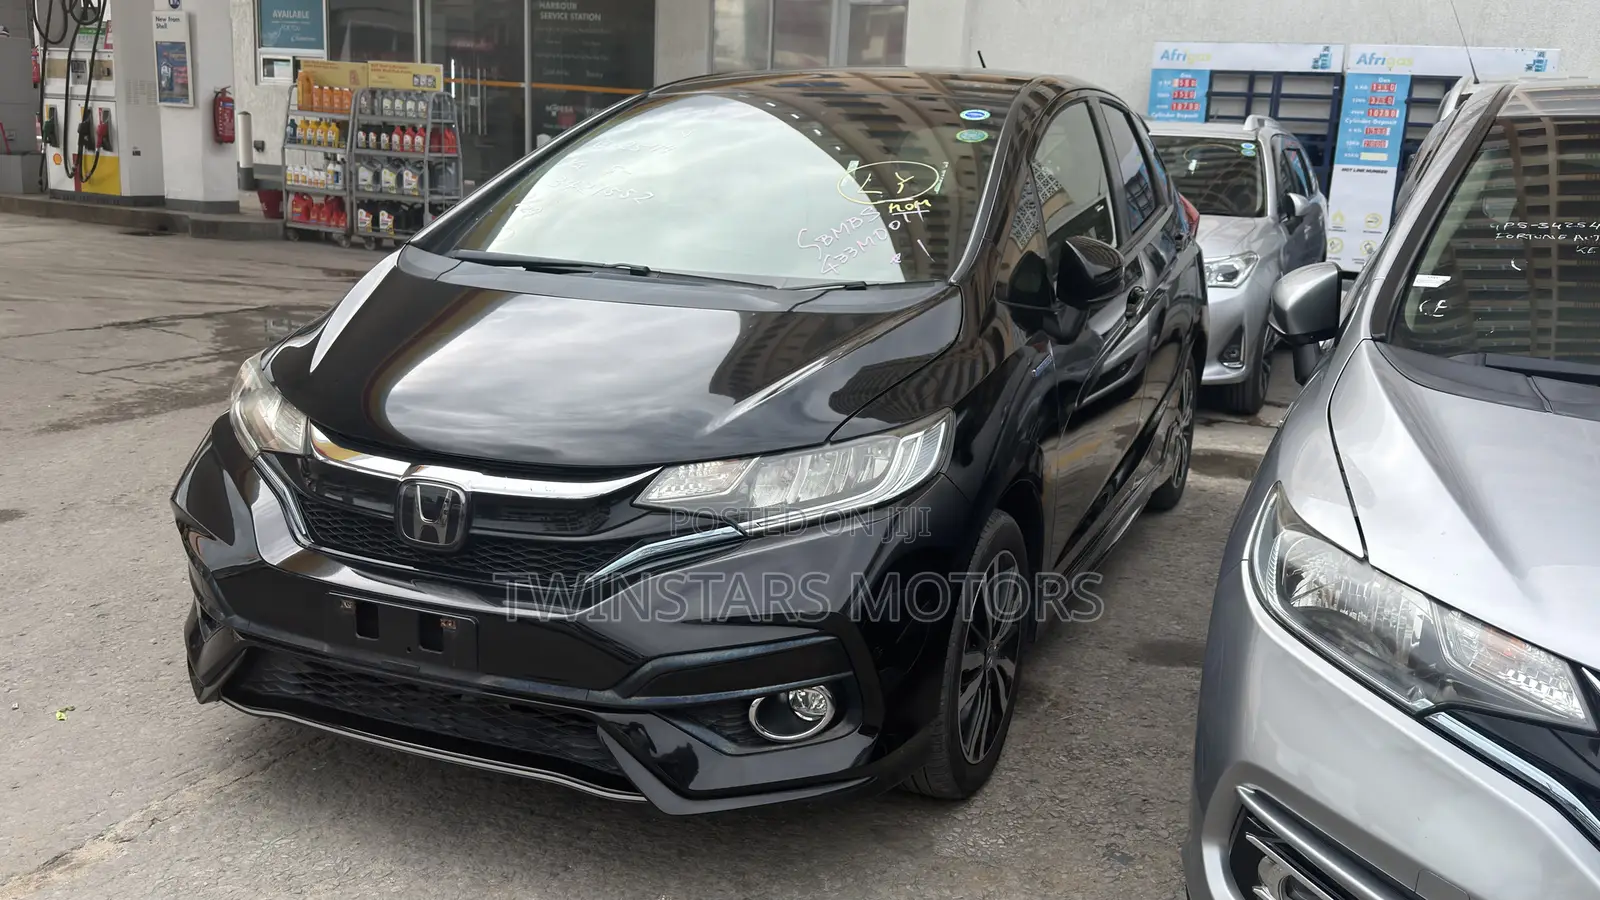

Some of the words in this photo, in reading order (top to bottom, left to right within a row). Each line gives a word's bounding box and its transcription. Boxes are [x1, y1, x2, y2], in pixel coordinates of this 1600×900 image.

[272, 9, 310, 19] AVAILABLE
[540, 12, 568, 20] SERVICE
[570, 13, 602, 21] STATION
[1160, 48, 1212, 65] Afrigas
[1356, 52, 1414, 68] Afrigas
